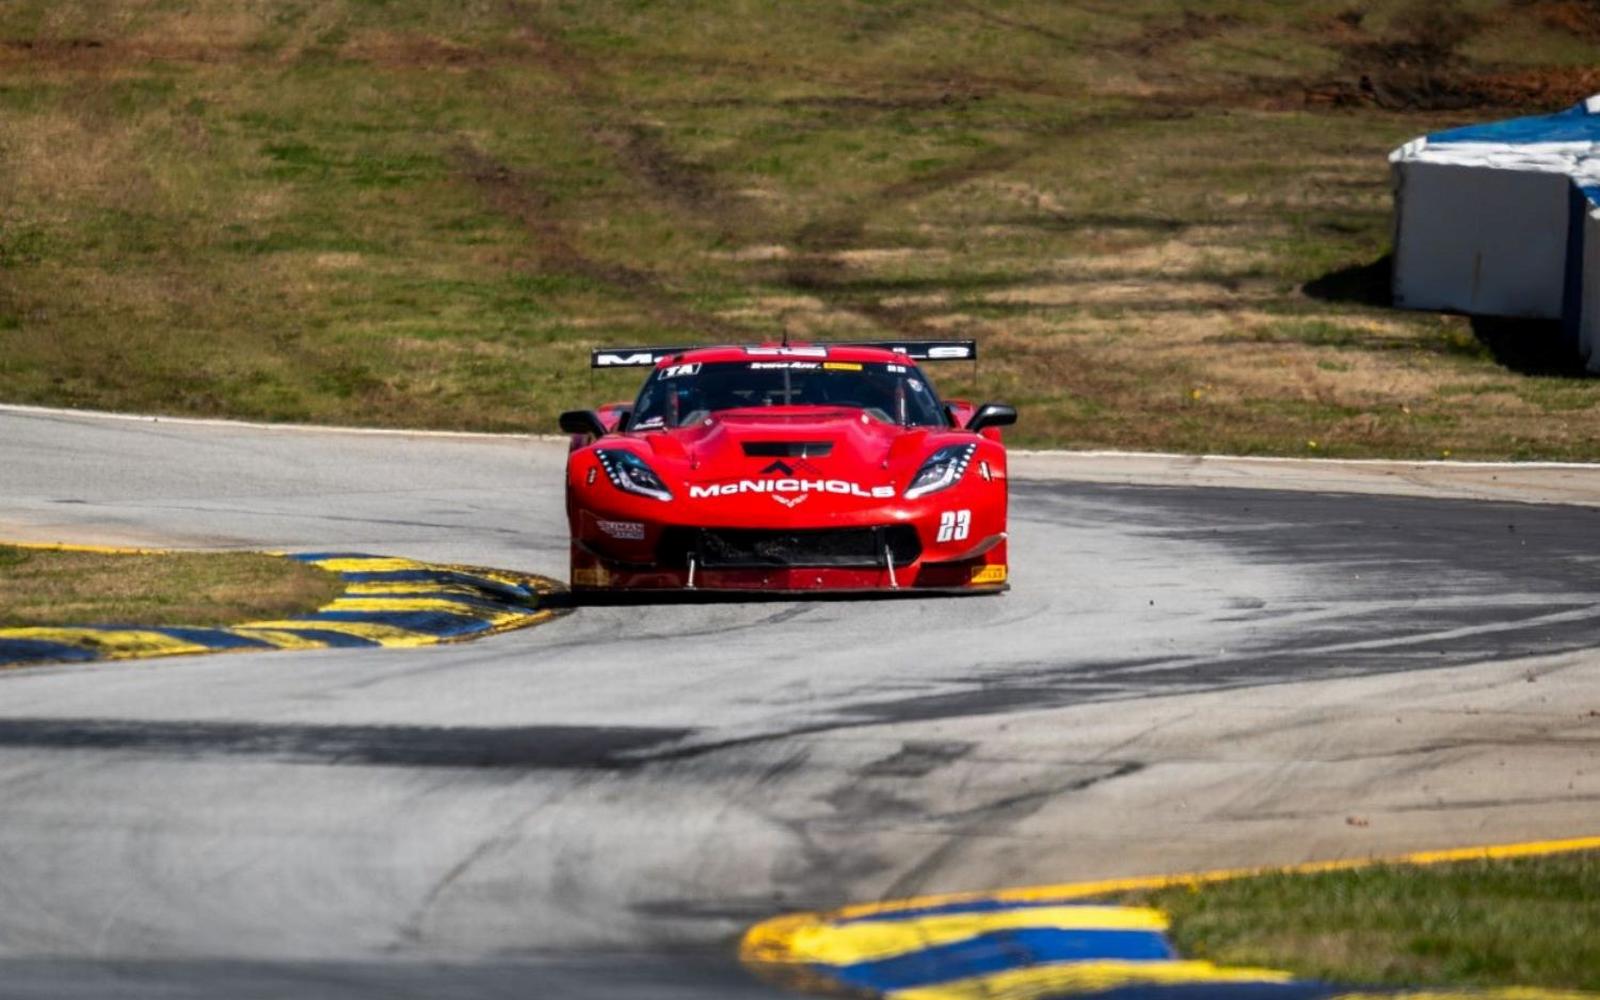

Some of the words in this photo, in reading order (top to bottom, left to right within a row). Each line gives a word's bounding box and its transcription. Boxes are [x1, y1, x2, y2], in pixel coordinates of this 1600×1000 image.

[665, 364, 694, 377] TA
[689, 478, 897, 499] McNICHOLS
[936, 509, 972, 543] 23
